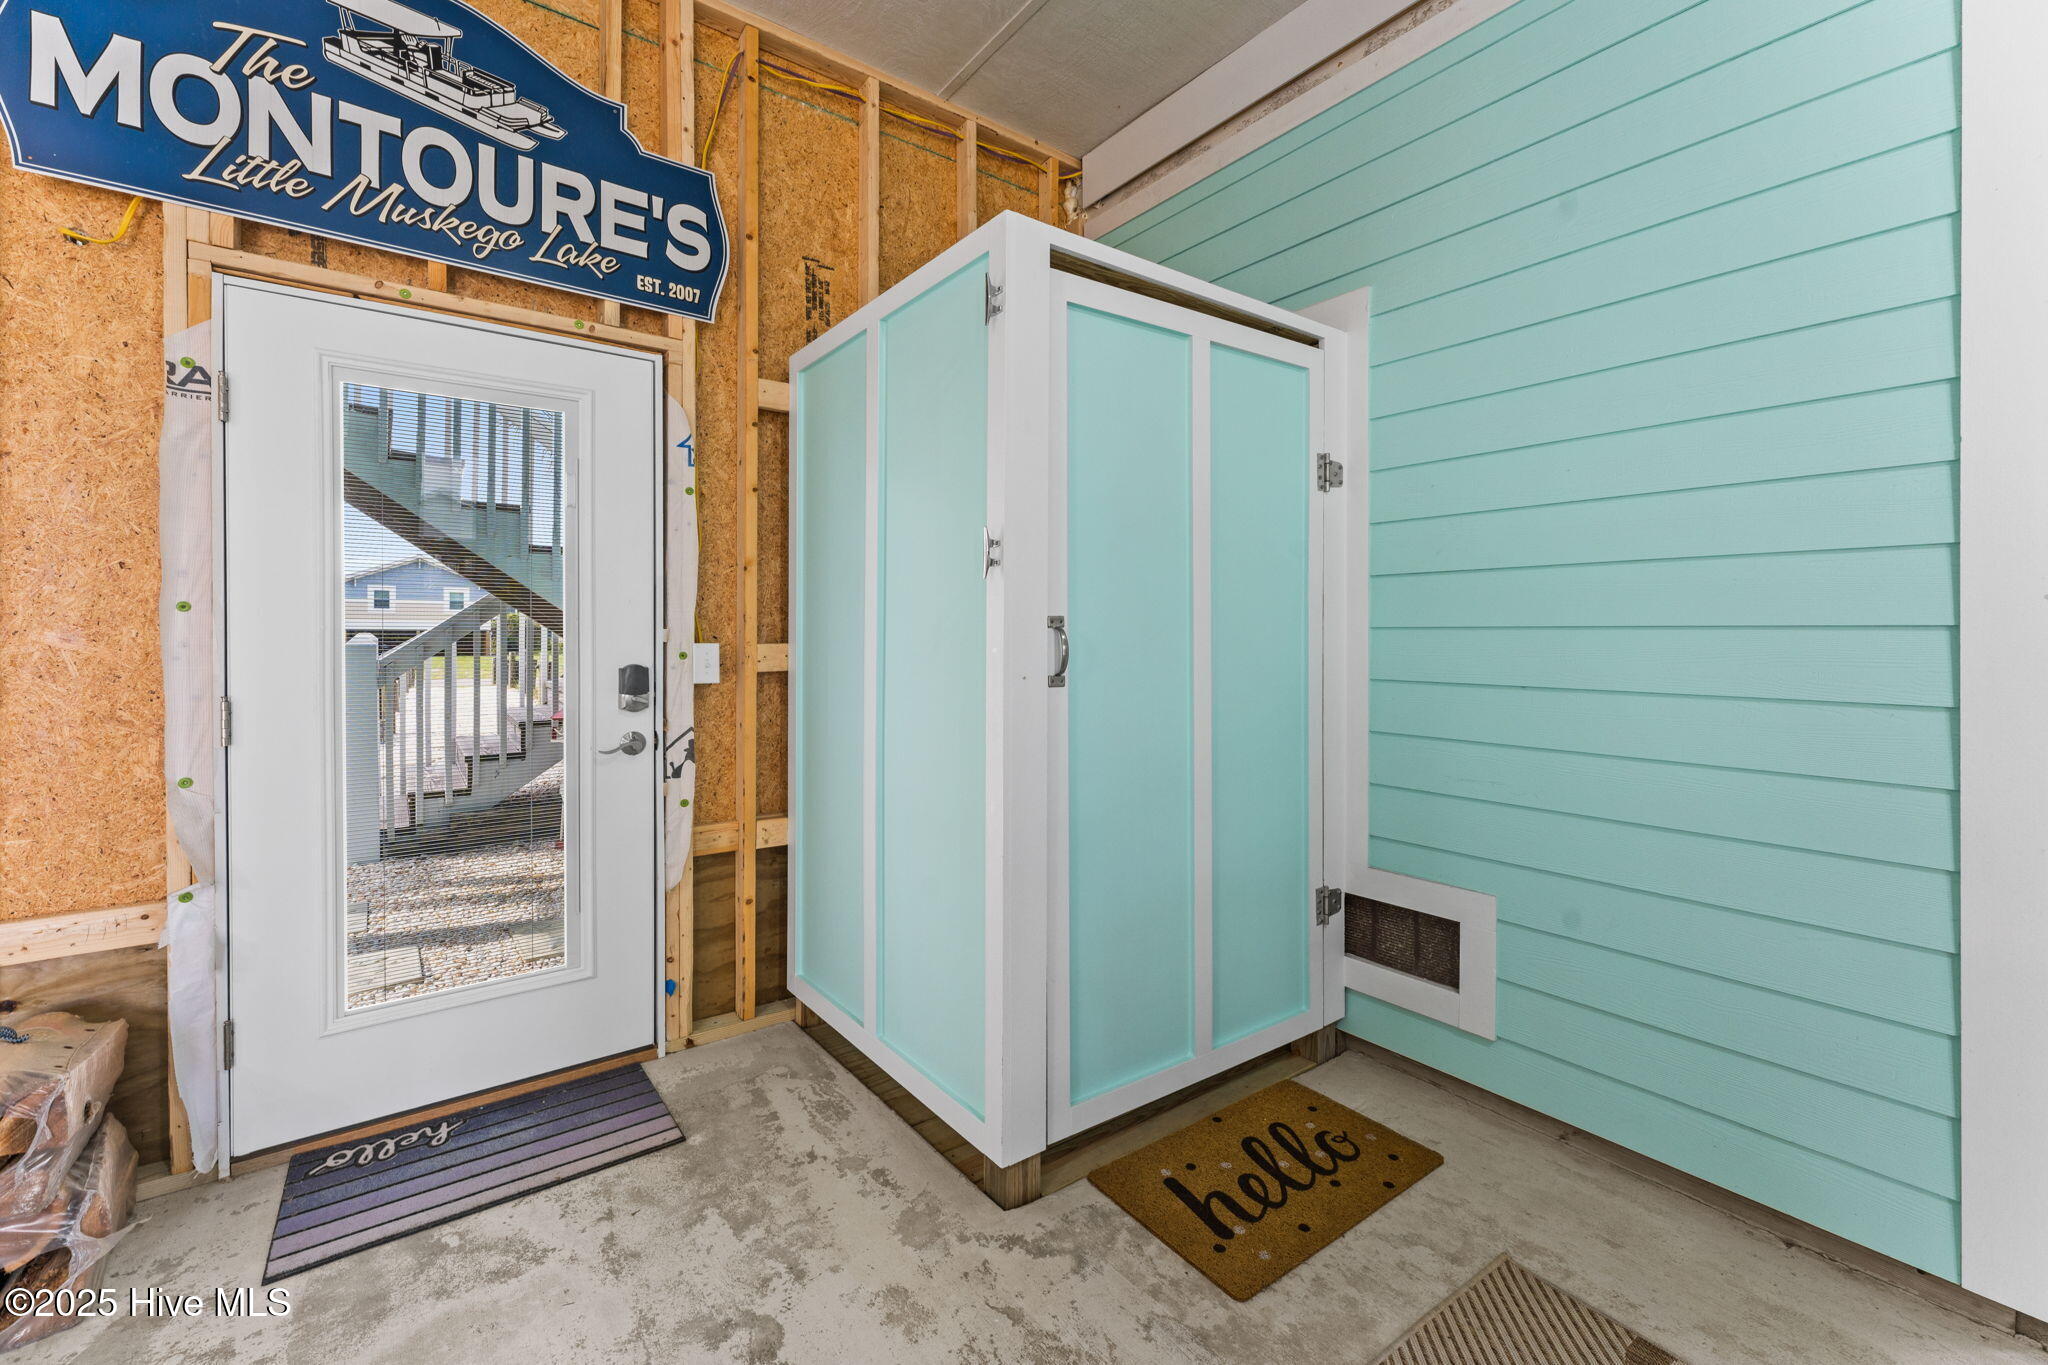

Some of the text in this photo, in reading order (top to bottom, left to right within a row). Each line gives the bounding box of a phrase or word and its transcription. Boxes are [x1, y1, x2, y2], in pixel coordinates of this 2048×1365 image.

[210, 21, 315, 90] The
[29, 9, 712, 272] MONTOURE'S
[181, 136, 315, 198] Little
[320, 174, 524, 260] Muskego
[528, 224, 621, 280] Lake
[636, 274, 701, 304] EST. 2007
[308, 1120, 467, 1177] hello
[1162, 1121, 1361, 1240] hello
